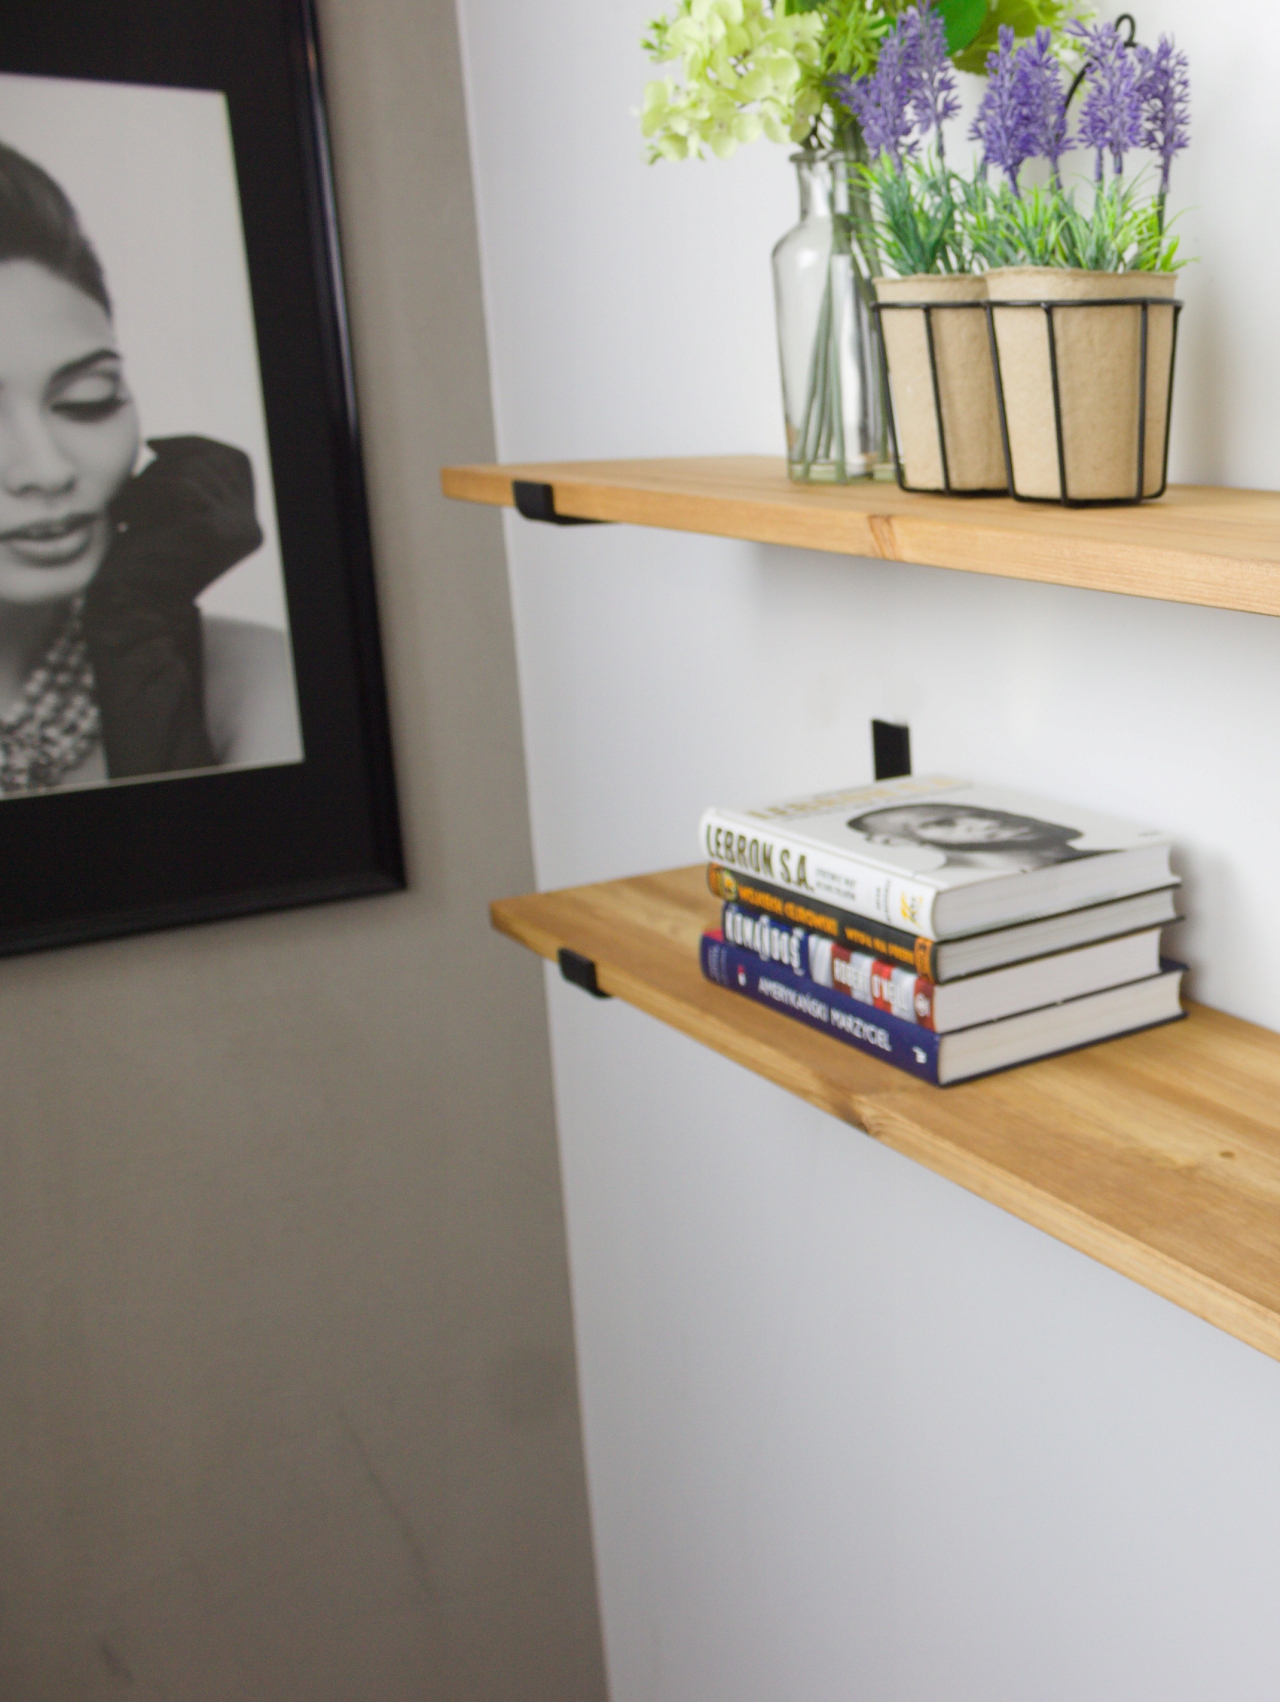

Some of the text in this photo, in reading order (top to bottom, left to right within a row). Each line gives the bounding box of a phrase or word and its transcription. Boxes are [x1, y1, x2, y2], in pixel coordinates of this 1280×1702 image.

[706, 824, 774, 878] LEBRON
[780, 848, 814, 892] S.A.
[833, 958, 870, 994] ROBERT
[757, 976, 893, 1052] AMERYKAŃSKI MARZYCIEL
